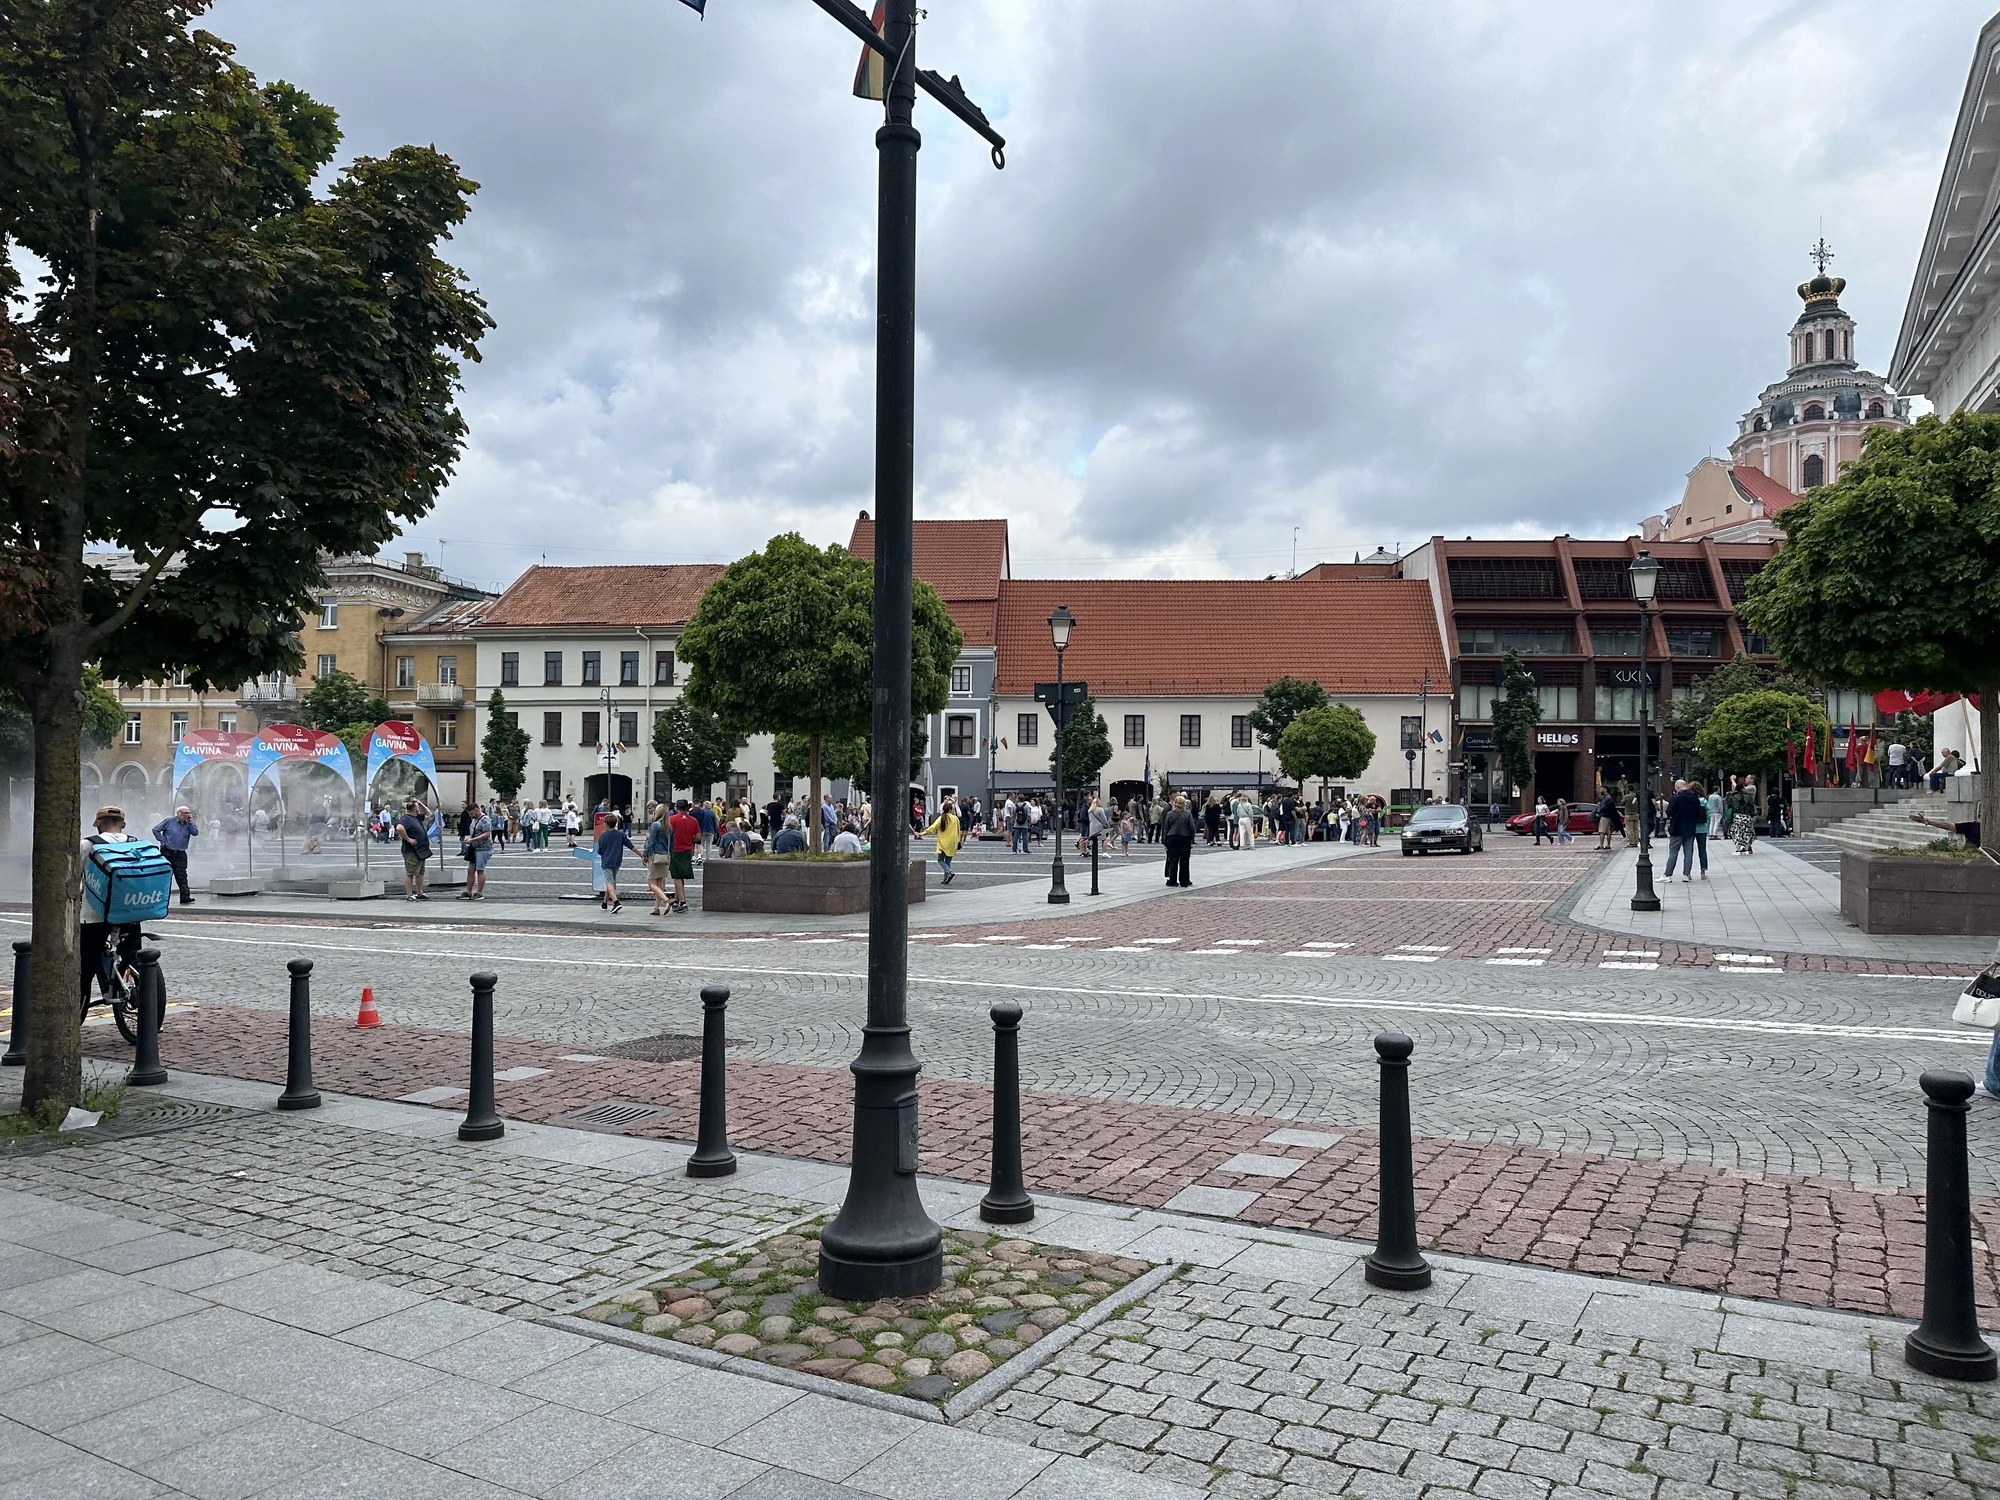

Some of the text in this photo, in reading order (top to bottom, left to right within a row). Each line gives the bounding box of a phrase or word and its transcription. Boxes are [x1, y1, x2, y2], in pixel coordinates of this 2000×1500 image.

[258, 742, 300, 751] GAIVINA
[375, 738, 407, 750] GAIVINA
[183, 746, 222, 755] GAIVINA
[123, 890, 163, 906] Wolt
